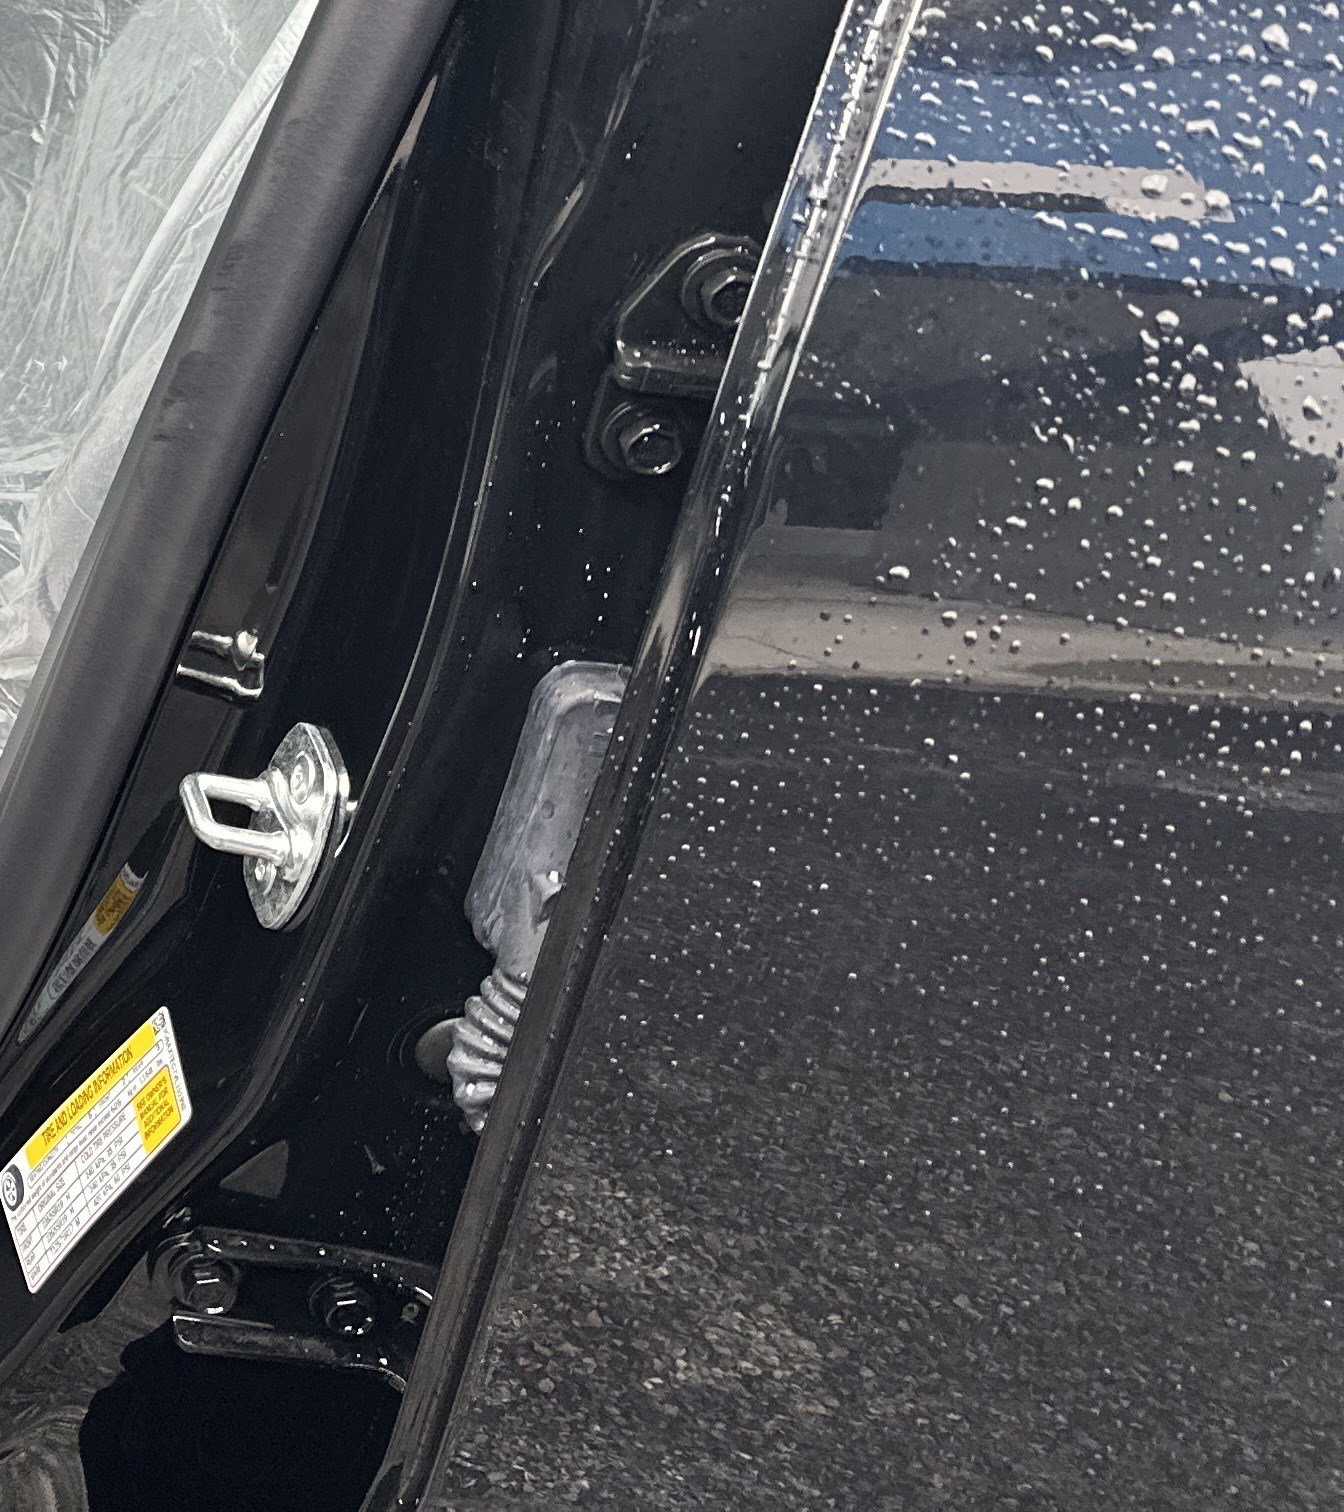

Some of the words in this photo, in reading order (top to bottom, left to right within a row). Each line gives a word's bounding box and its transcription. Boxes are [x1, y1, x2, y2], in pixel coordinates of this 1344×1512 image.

[41, 1122, 56, 1147] TIRE
[53, 1110, 68, 1134] AND
[66, 1083, 94, 1120] LOADING
[92, 1044, 133, 1095] INFORMATION
[144, 1103, 173, 1142] INFORMATION
